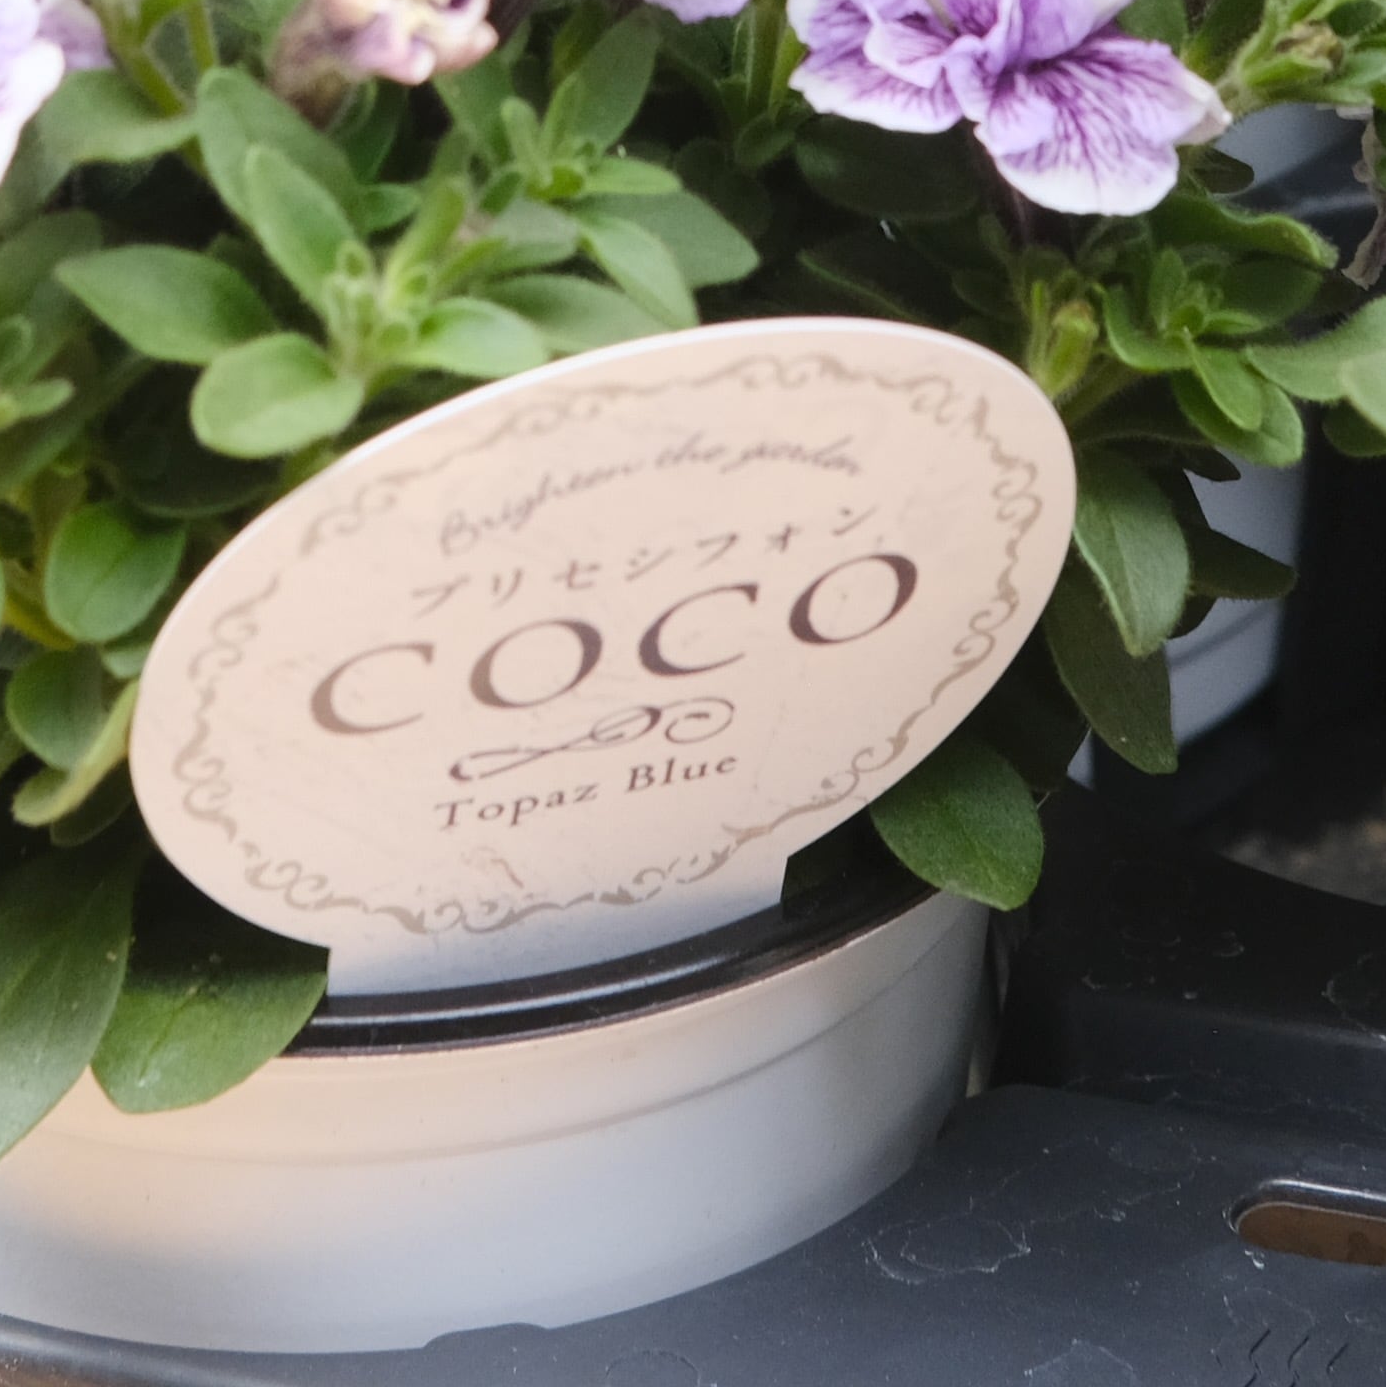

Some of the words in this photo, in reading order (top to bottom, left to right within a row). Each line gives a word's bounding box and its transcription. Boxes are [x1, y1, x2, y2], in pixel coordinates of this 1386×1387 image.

[654, 432, 727, 471] the
[309, 552, 918, 736] COCO
[432, 781, 601, 830] Topaz
[625, 753, 741, 795] Blue
